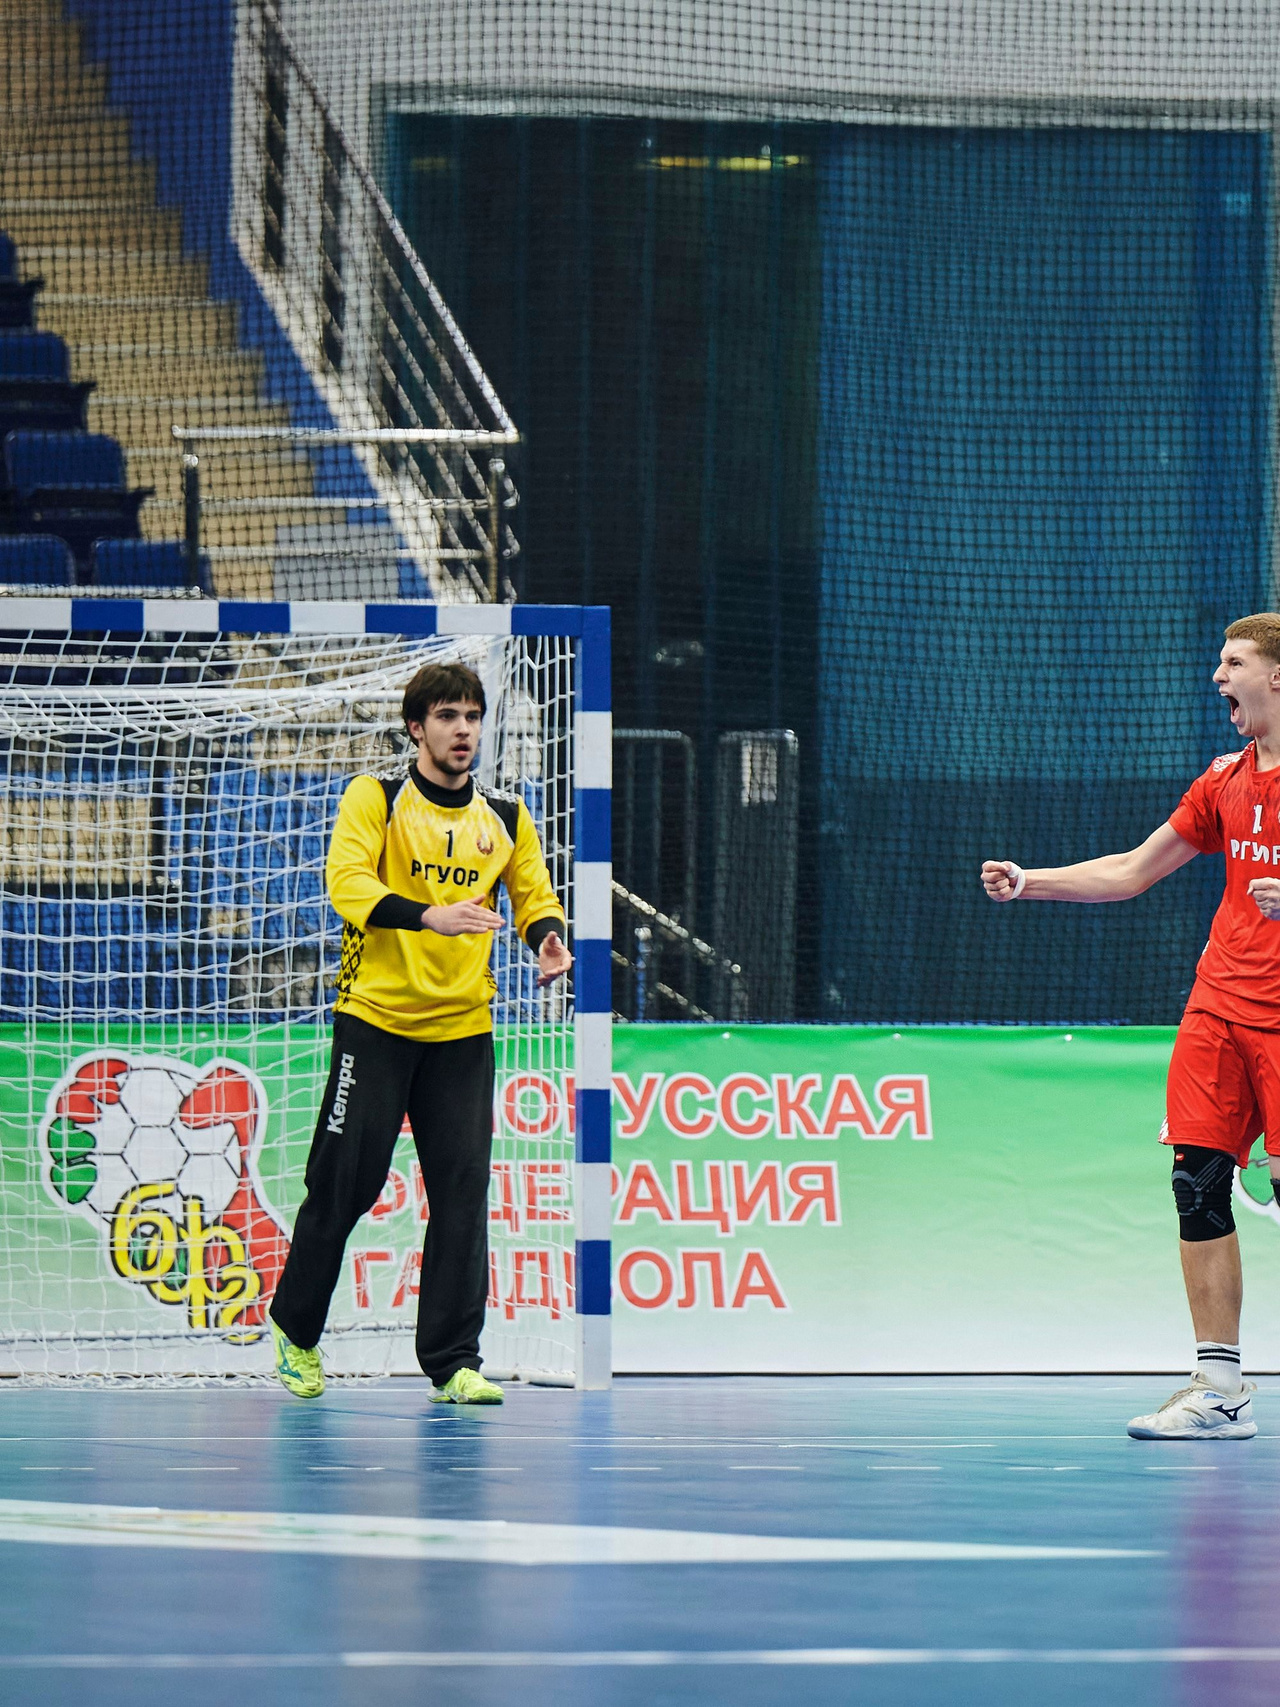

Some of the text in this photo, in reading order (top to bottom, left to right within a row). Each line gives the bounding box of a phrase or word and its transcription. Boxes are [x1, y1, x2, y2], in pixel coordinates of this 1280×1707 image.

[1252, 804, 1263, 835] 1
[445, 829, 453, 858] 1
[411, 858, 479, 888] РГУОР
[326, 1052, 357, 1135] Kempa
